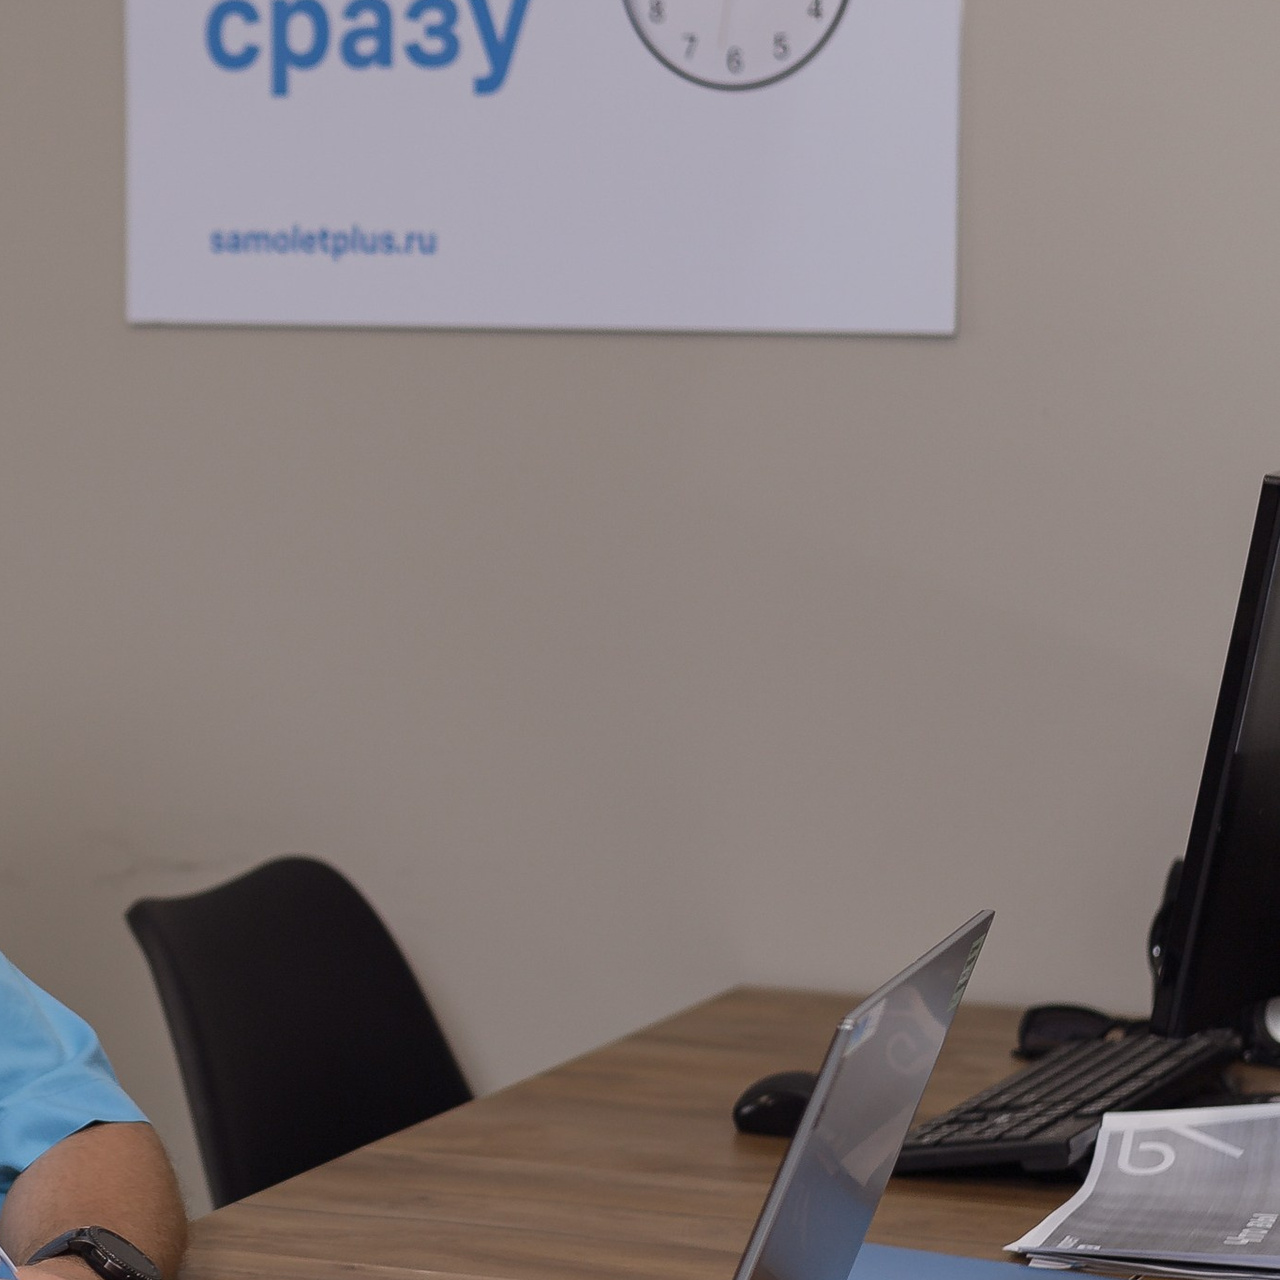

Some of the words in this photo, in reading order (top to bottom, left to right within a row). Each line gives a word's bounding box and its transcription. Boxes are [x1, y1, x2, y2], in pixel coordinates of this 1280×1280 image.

[682, 32, 698, 59] 7
[725, 46, 744, 74] 6
[772, 31, 791, 61] 5
[209, 224, 438, 261] samoletplus.ru
